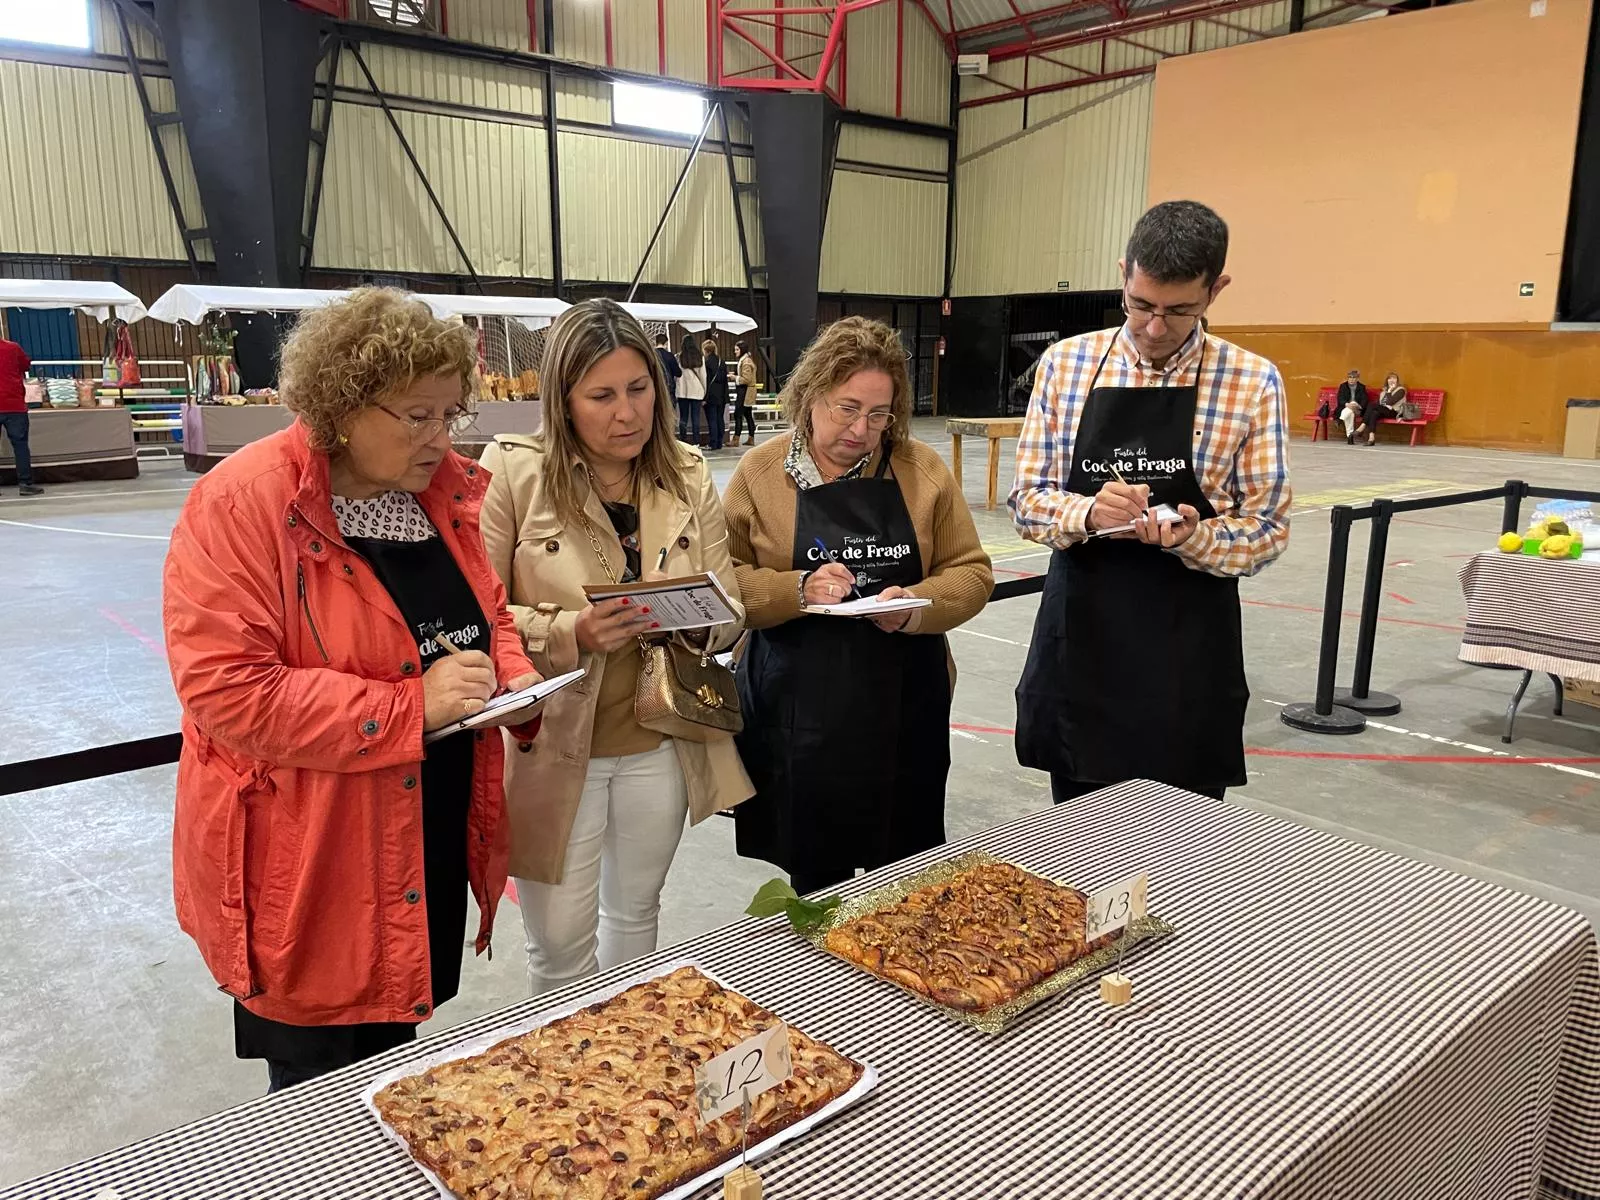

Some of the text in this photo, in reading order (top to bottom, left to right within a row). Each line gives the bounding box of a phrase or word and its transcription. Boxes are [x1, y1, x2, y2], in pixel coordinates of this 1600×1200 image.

[1081, 457, 1186, 473] Coc de Fraga
[842, 546, 863, 559] de
[866, 543, 911, 559] Fraga
[419, 638, 439, 656] de
[439, 624, 480, 645] raga
[1100, 891, 1130, 926] 13
[720, 1048, 764, 1101] 12
